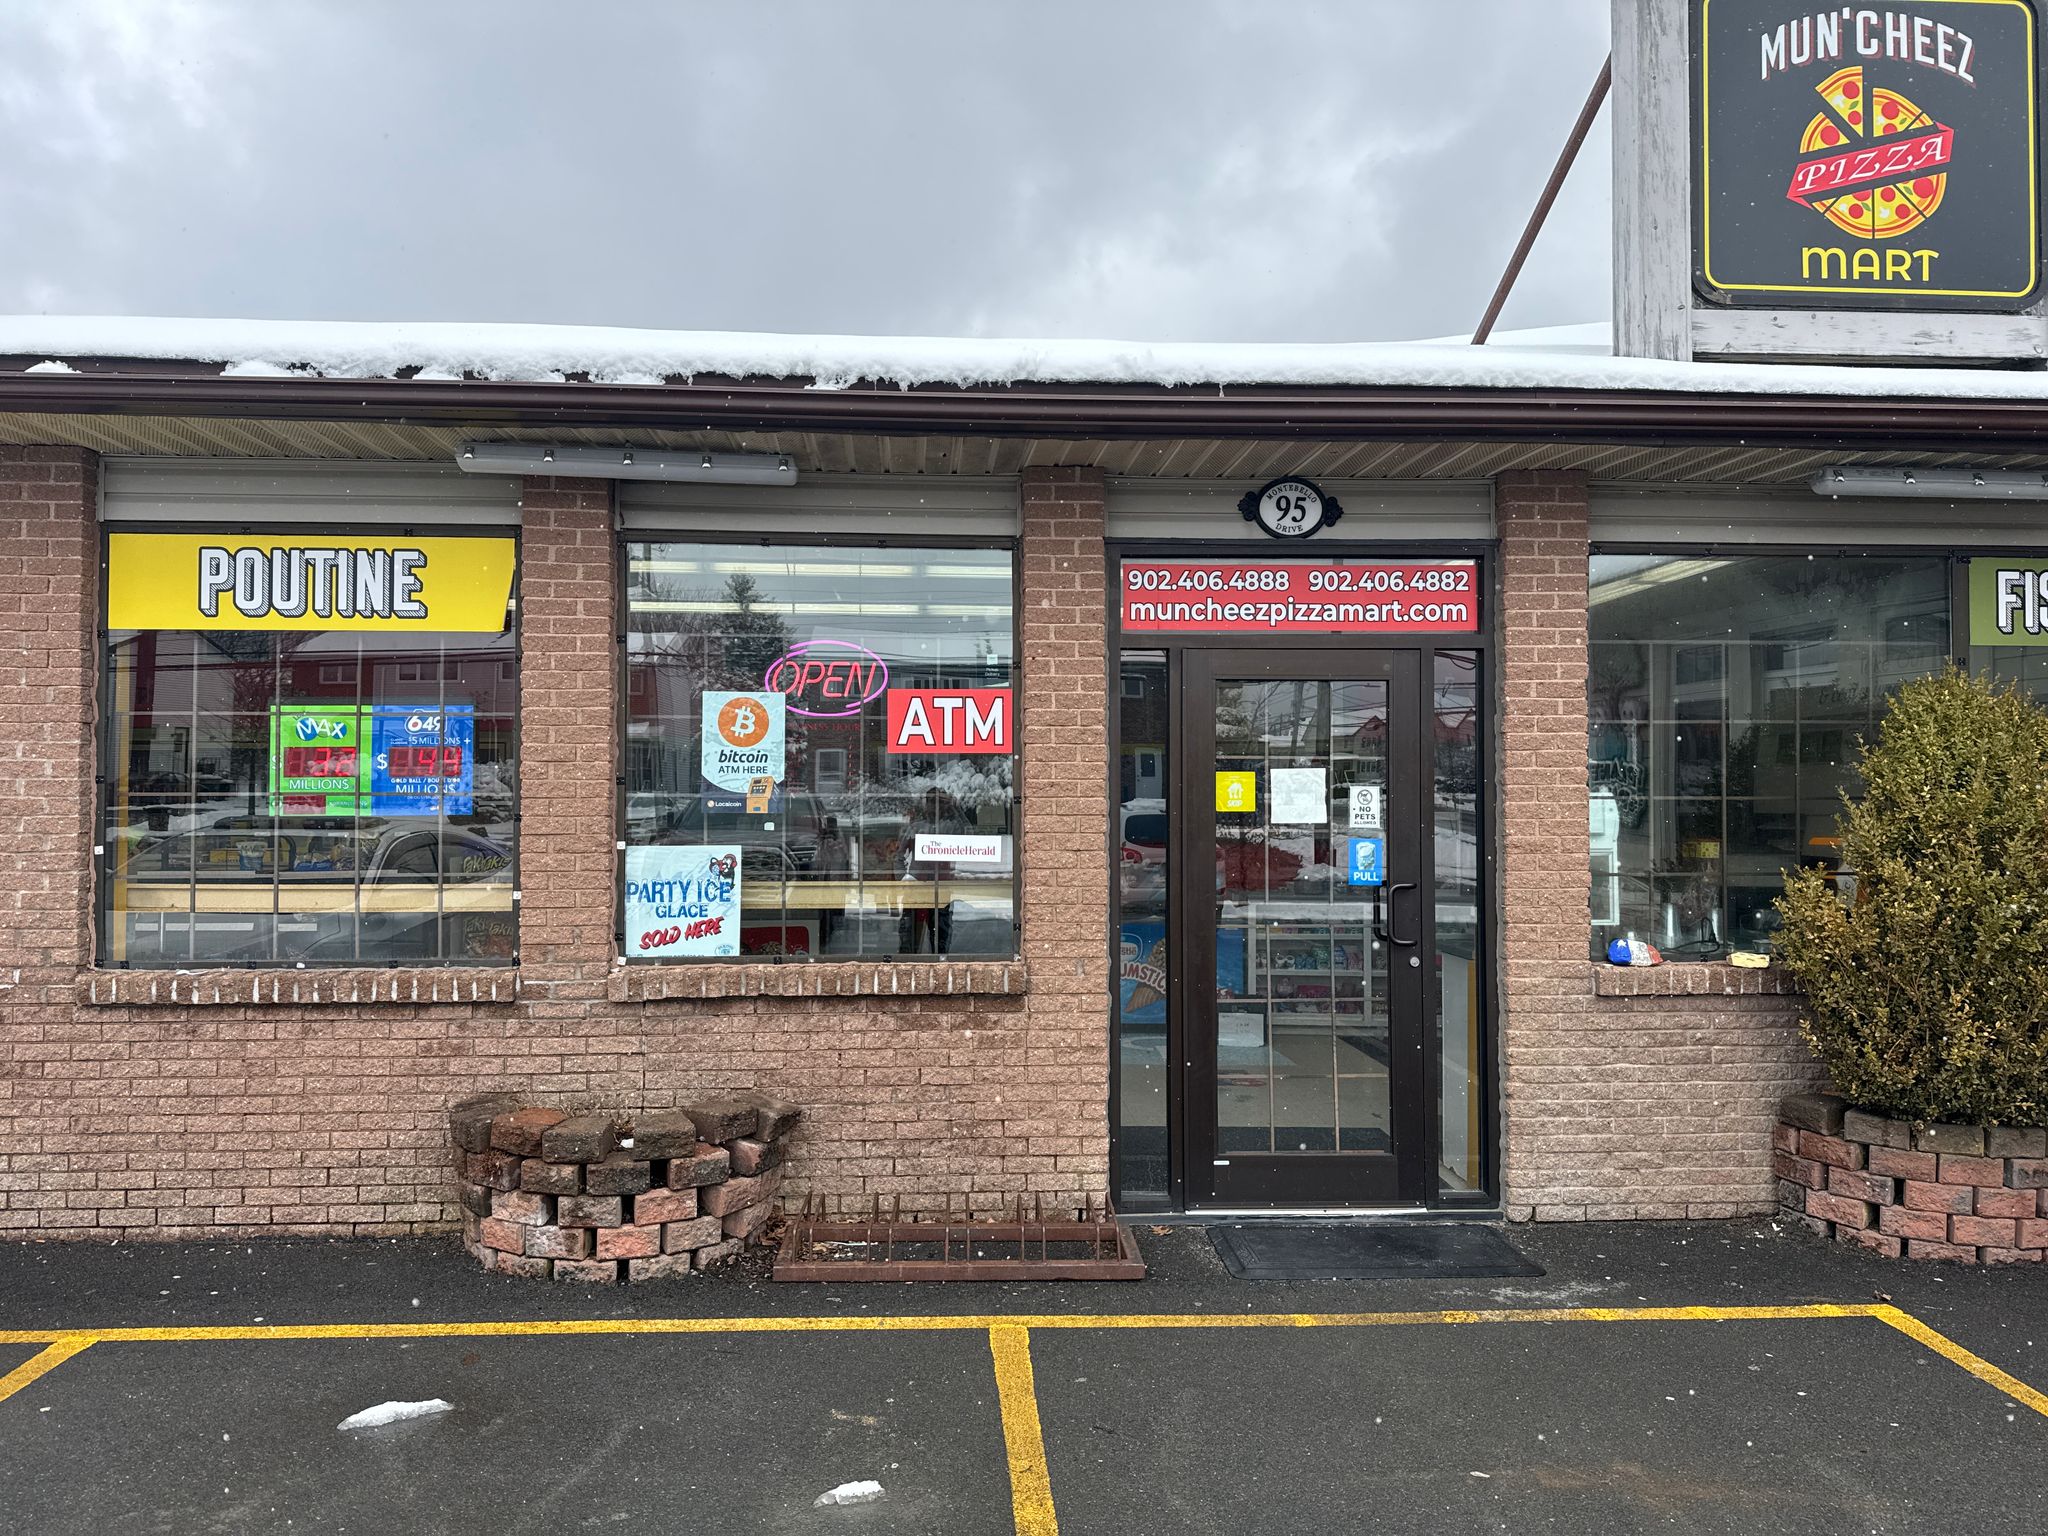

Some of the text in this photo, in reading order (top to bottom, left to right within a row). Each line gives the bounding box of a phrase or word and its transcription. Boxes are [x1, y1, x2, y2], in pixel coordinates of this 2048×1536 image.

[1761, 7, 1975, 86] MUN'CHEEZ
[1797, 135, 1947, 191] PIZZA
[1266, 484, 1318, 503] MONTEBELLO
[1275, 495, 1307, 523] 95
[1275, 522, 1304, 533] DRIVE
[199, 546, 428, 619] POUTINE
[1127, 569, 1470, 592] 902.406.4888 902.406.4882
[1129, 597, 1468, 627] muncheezpizzamart.com
[772, 660, 877, 698] OPEN
[296, 717, 345, 740] MAX
[896, 696, 1005, 746] ATM
[718, 749, 769, 763] bitcoin
[718, 766, 769, 774] ATM HERE
[715, 800, 742, 808] Localcoin
[921, 845, 996, 856] ChronicleHerald
[1353, 872, 1379, 881] PULL
[625, 878, 732, 903] PARTY ICE
[655, 904, 709, 918] GLACE
[639, 915, 725, 950] SOLD HERE
